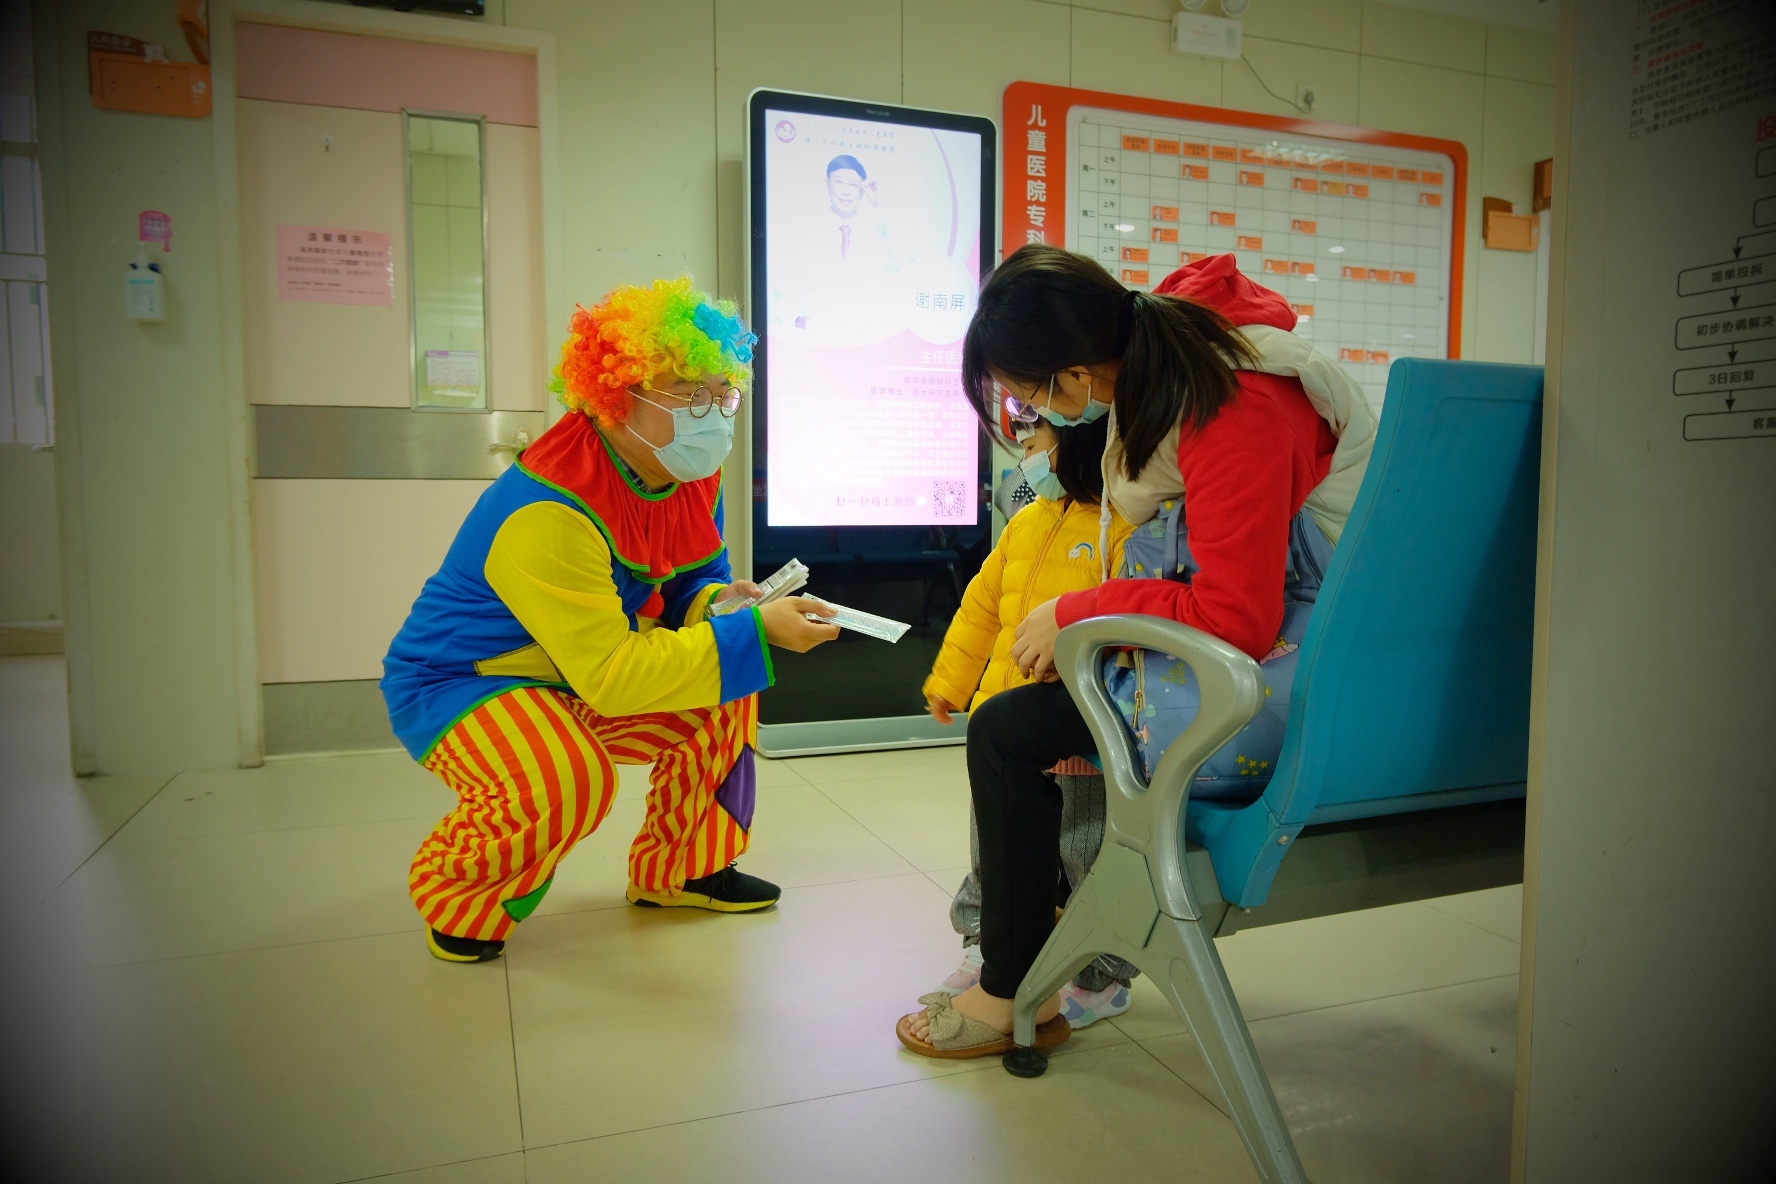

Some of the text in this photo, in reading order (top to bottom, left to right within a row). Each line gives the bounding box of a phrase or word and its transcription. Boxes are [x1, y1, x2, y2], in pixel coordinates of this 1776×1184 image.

[1103, 155, 1116, 163] 上午
[1103, 177, 1116, 186] 下午
[914, 291, 965, 311] 谢南屏
[1696, 315, 1774, 337] 初步协调解决
[920, 350, 962, 365] 主任医
[1708, 369, 1755, 385] 3日回复
[870, 386, 963, 397] 医学博士、硕士研究生导
